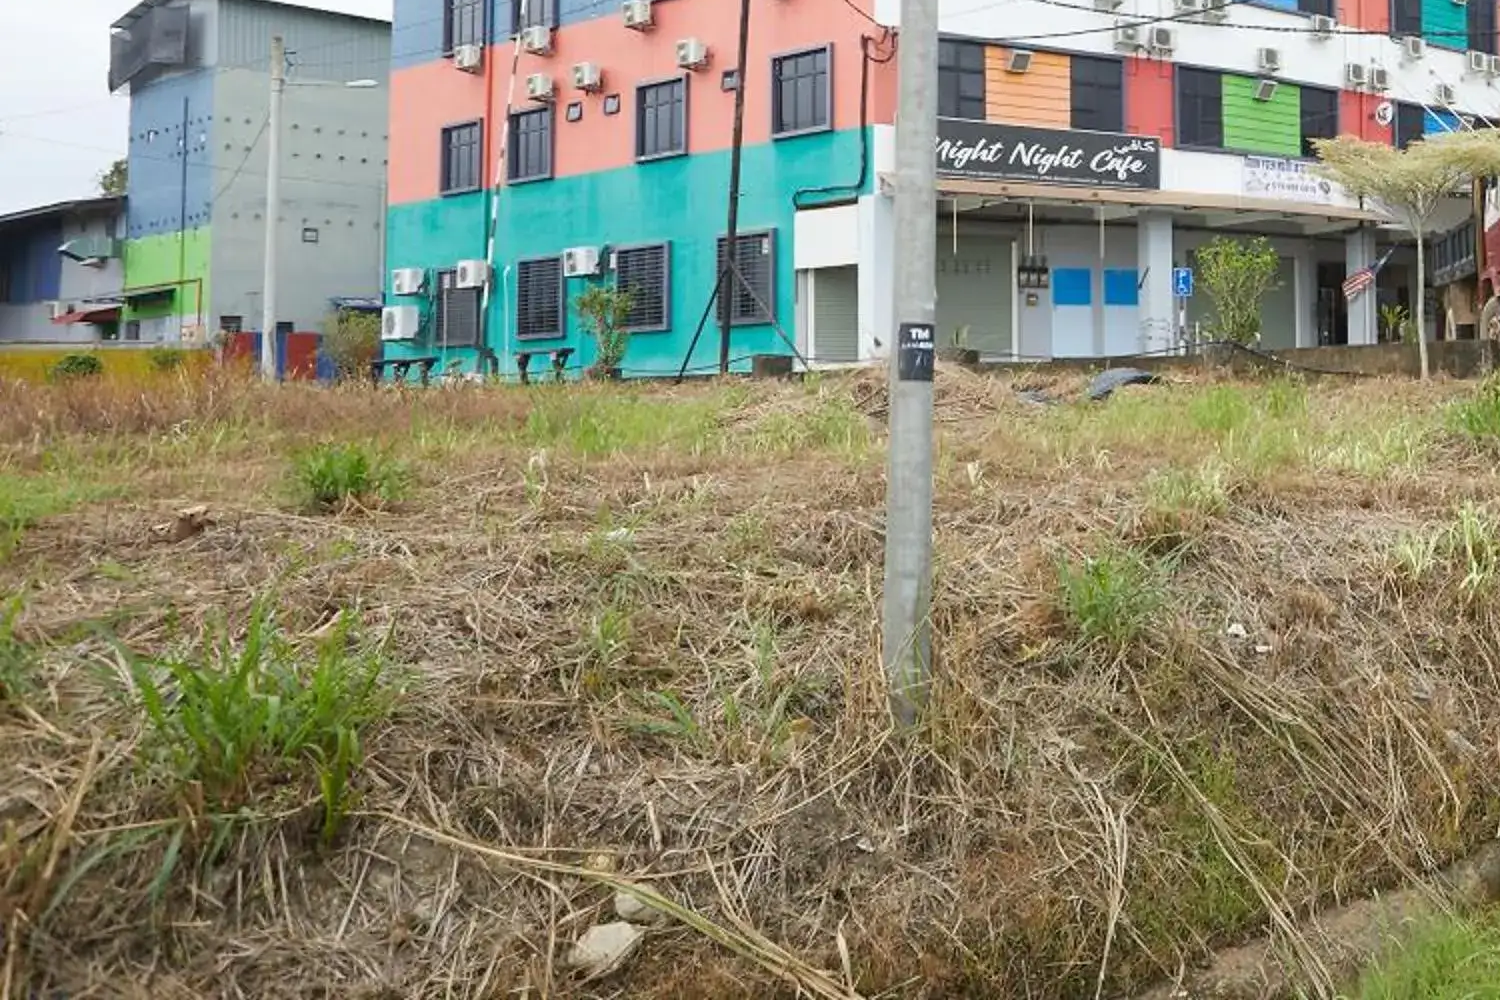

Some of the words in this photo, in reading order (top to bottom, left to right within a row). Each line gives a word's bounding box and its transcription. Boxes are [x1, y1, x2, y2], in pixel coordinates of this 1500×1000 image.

[934, 136, 1003, 169] Night
[1008, 141, 1083, 174] Night
[1089, 149, 1147, 181] Cafe
[908, 327, 931, 341] TM
